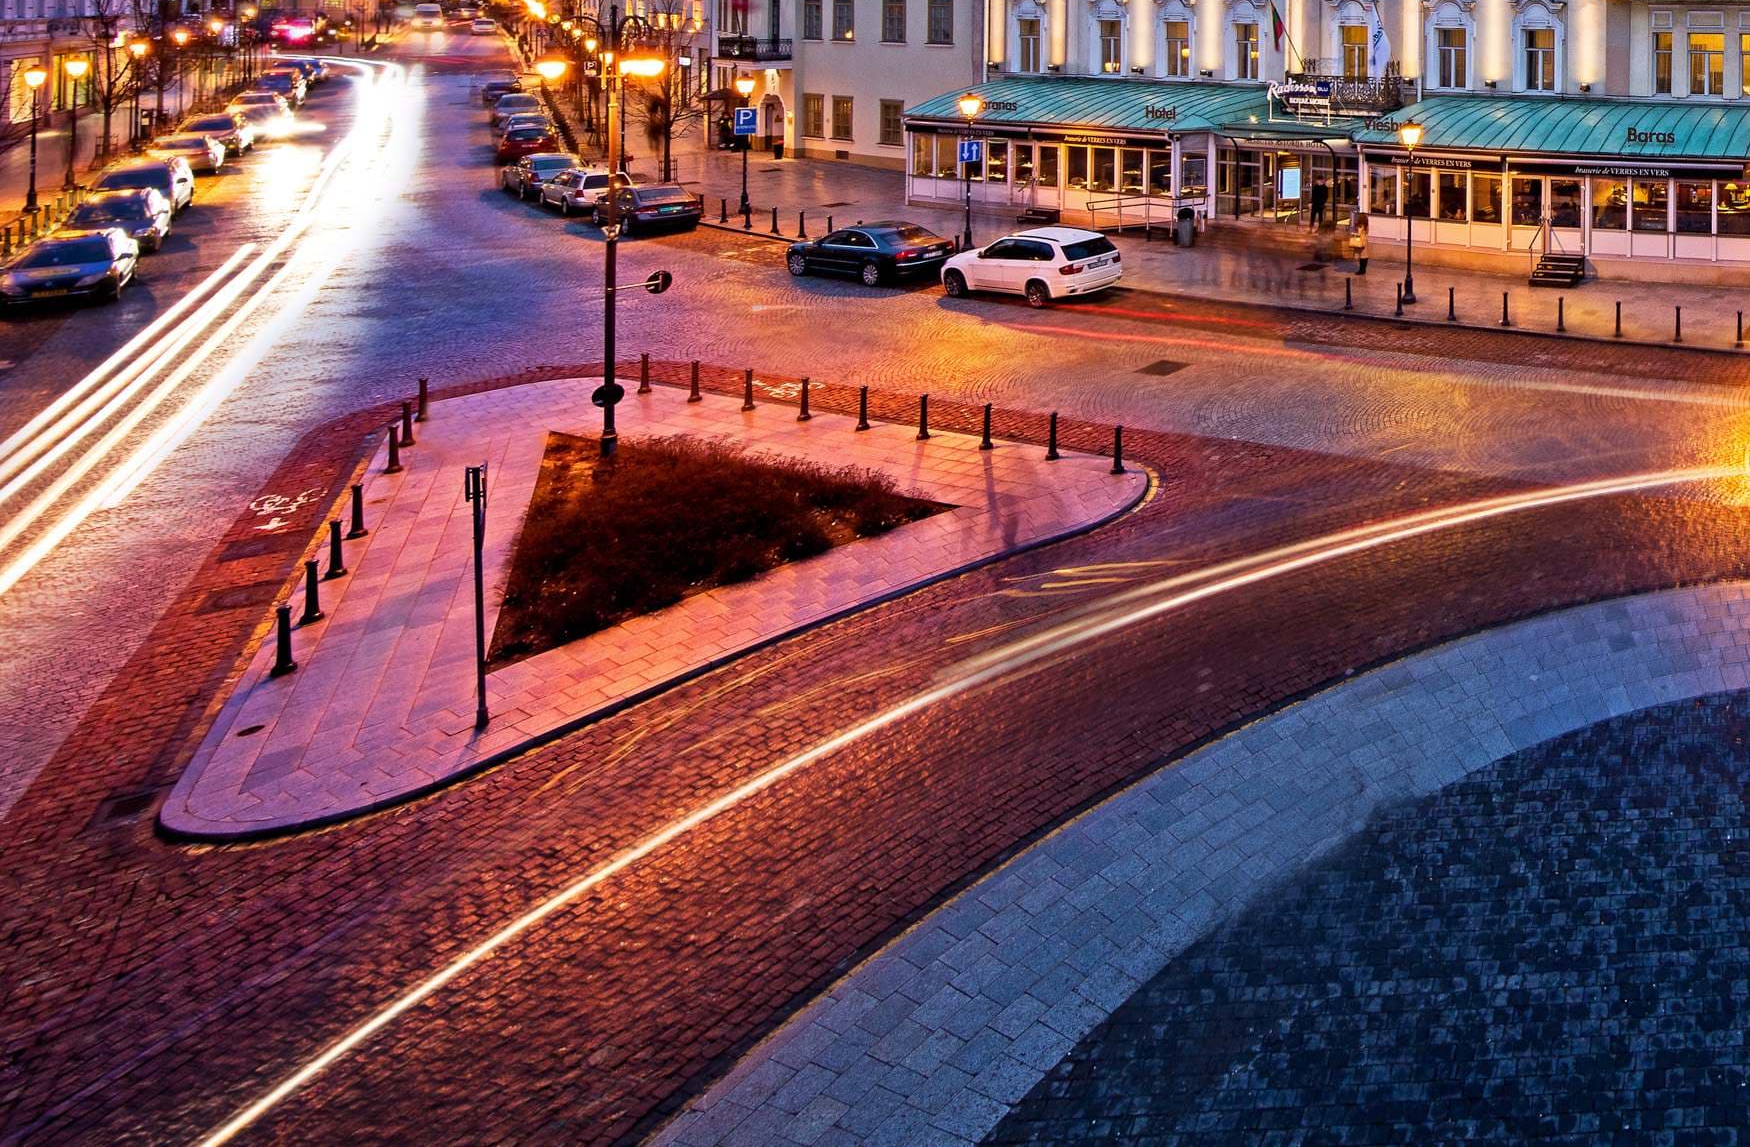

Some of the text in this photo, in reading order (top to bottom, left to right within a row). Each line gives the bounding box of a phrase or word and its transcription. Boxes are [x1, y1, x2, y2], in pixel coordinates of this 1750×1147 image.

[1267, 77, 1317, 101] Radisson
[740, 109, 753, 125] P
[1145, 105, 1176, 120] Hotel
[1627, 127, 1675, 144] Baras
[1391, 156, 1412, 164] brasser
[1422, 158, 1445, 166] VERRES
[1455, 160, 1472, 168] VERS
[1575, 166, 1601, 175] brasserie
[1650, 169, 1669, 177] VERS
